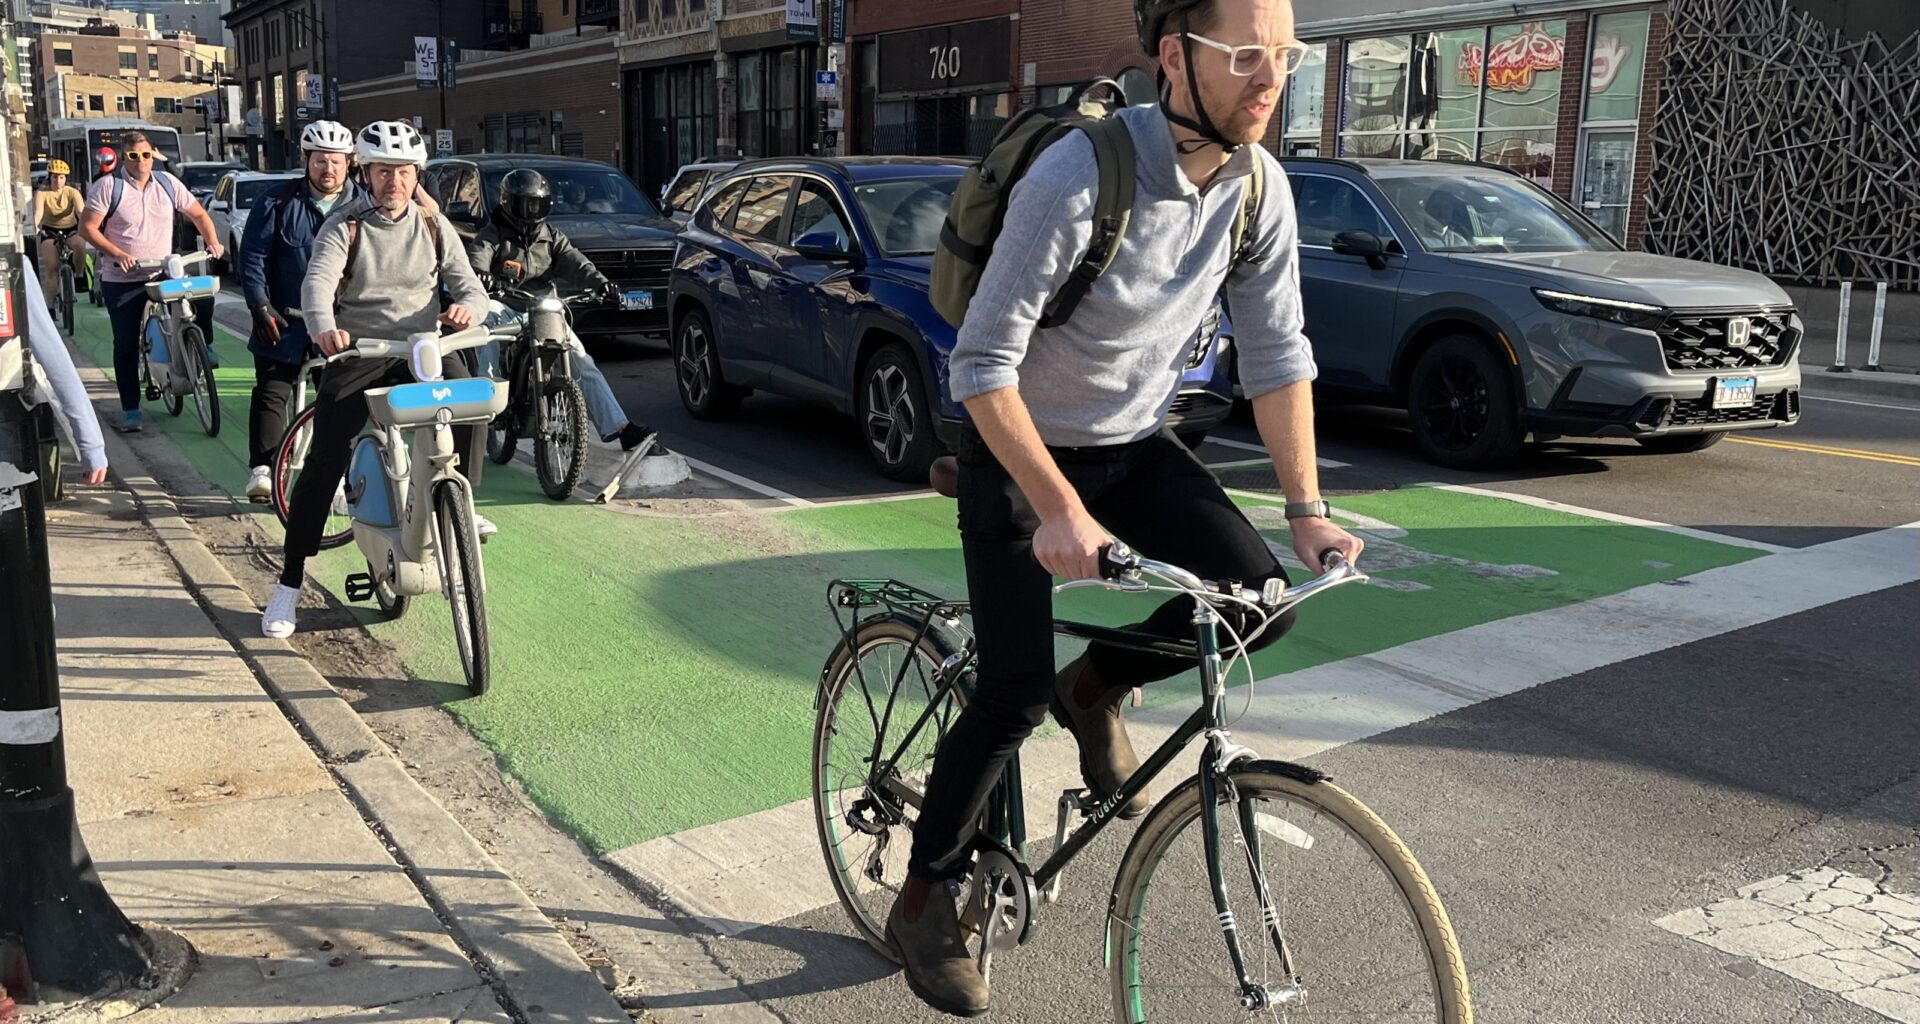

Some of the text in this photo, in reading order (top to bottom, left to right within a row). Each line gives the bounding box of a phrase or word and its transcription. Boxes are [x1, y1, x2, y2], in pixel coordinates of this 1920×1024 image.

[833, 12, 841, 39] RIVER
[930, 46, 961, 79] 760
[438, 140, 451, 149] 25
[431, 387, 453, 401] lyft
[1091, 788, 1124, 824] PUBLIC
